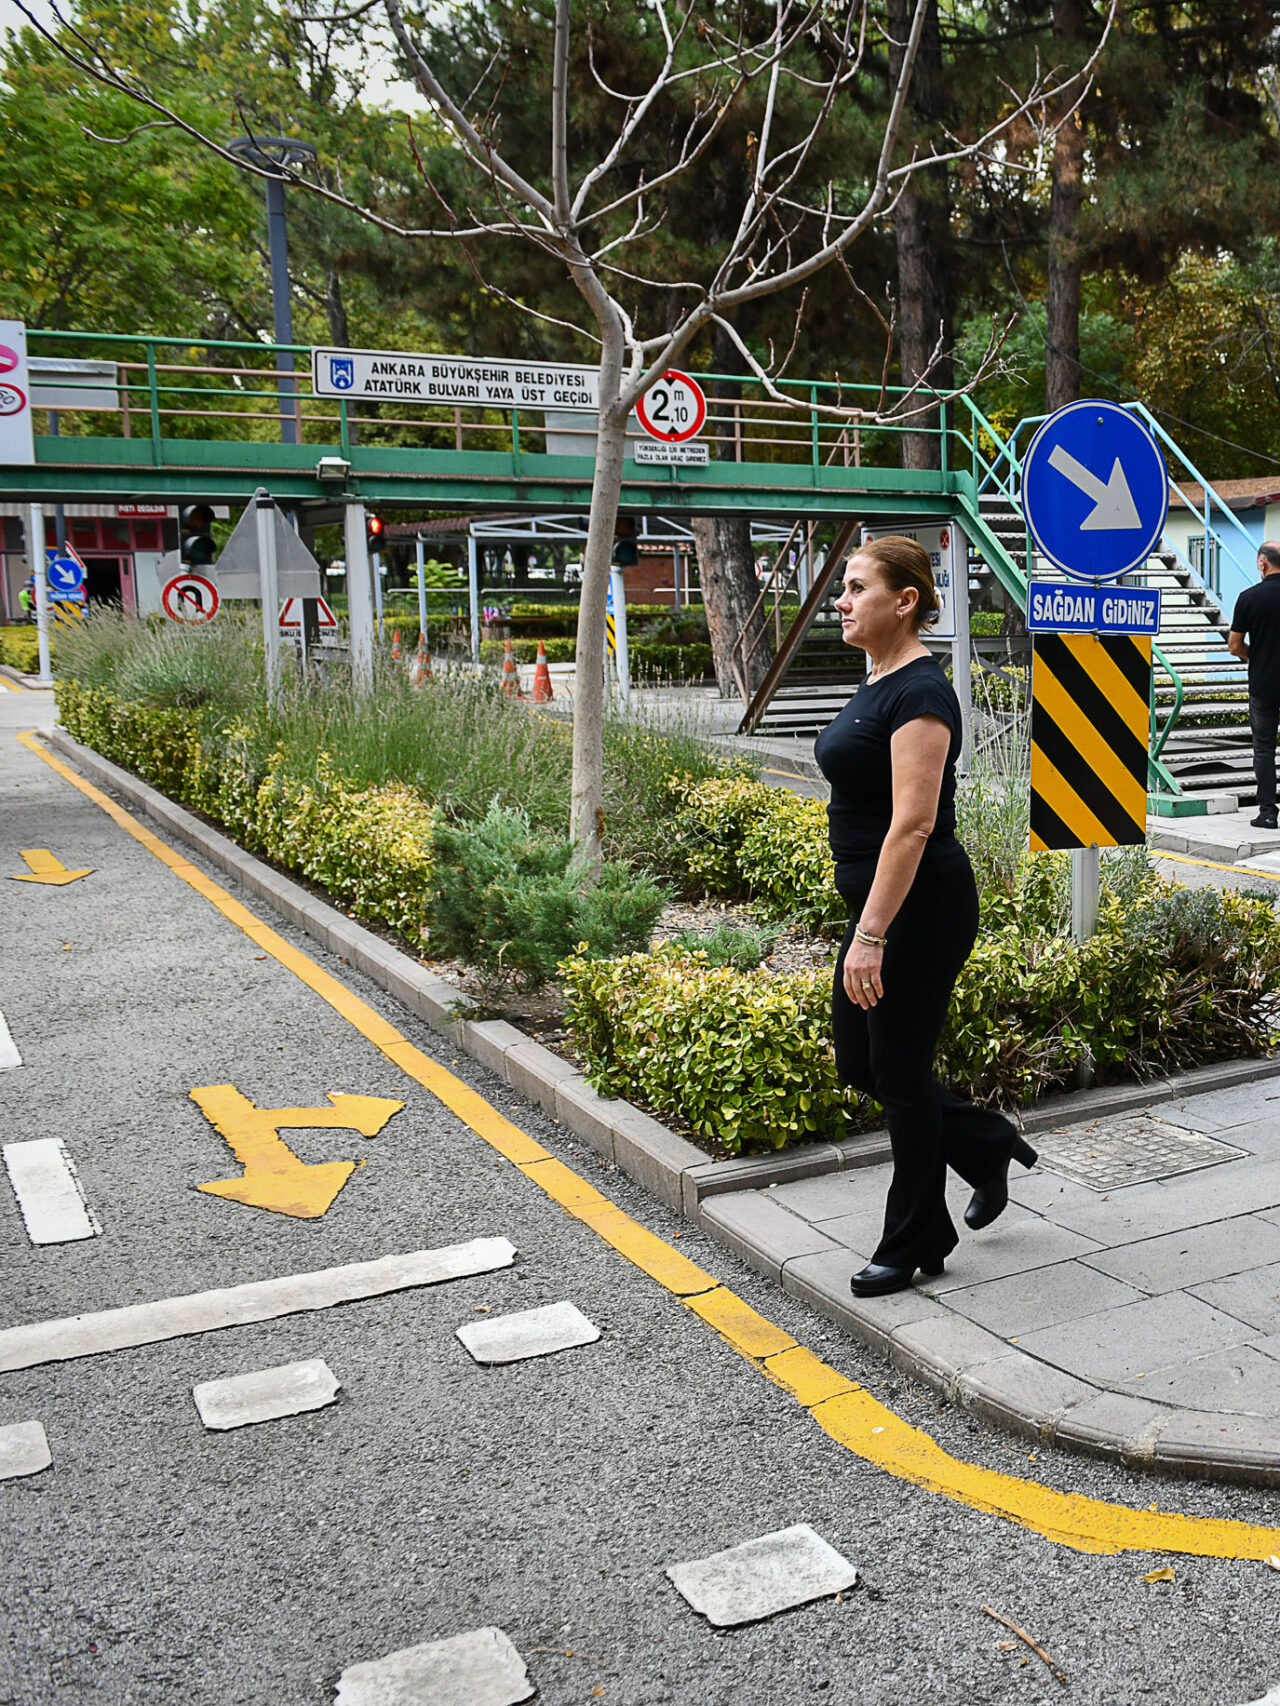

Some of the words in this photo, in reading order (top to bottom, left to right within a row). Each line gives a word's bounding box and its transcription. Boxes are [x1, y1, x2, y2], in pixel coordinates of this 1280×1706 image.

[371, 362, 425, 377] ANKARA
[364, 378, 421, 394] ATATÜRK
[428, 383, 479, 397] BULVARI
[486, 386, 514, 399] YAYA
[521, 386, 546, 401] ÜST
[674, 390, 684, 401] m
[1033, 589, 1095, 623] SAĞDAN
